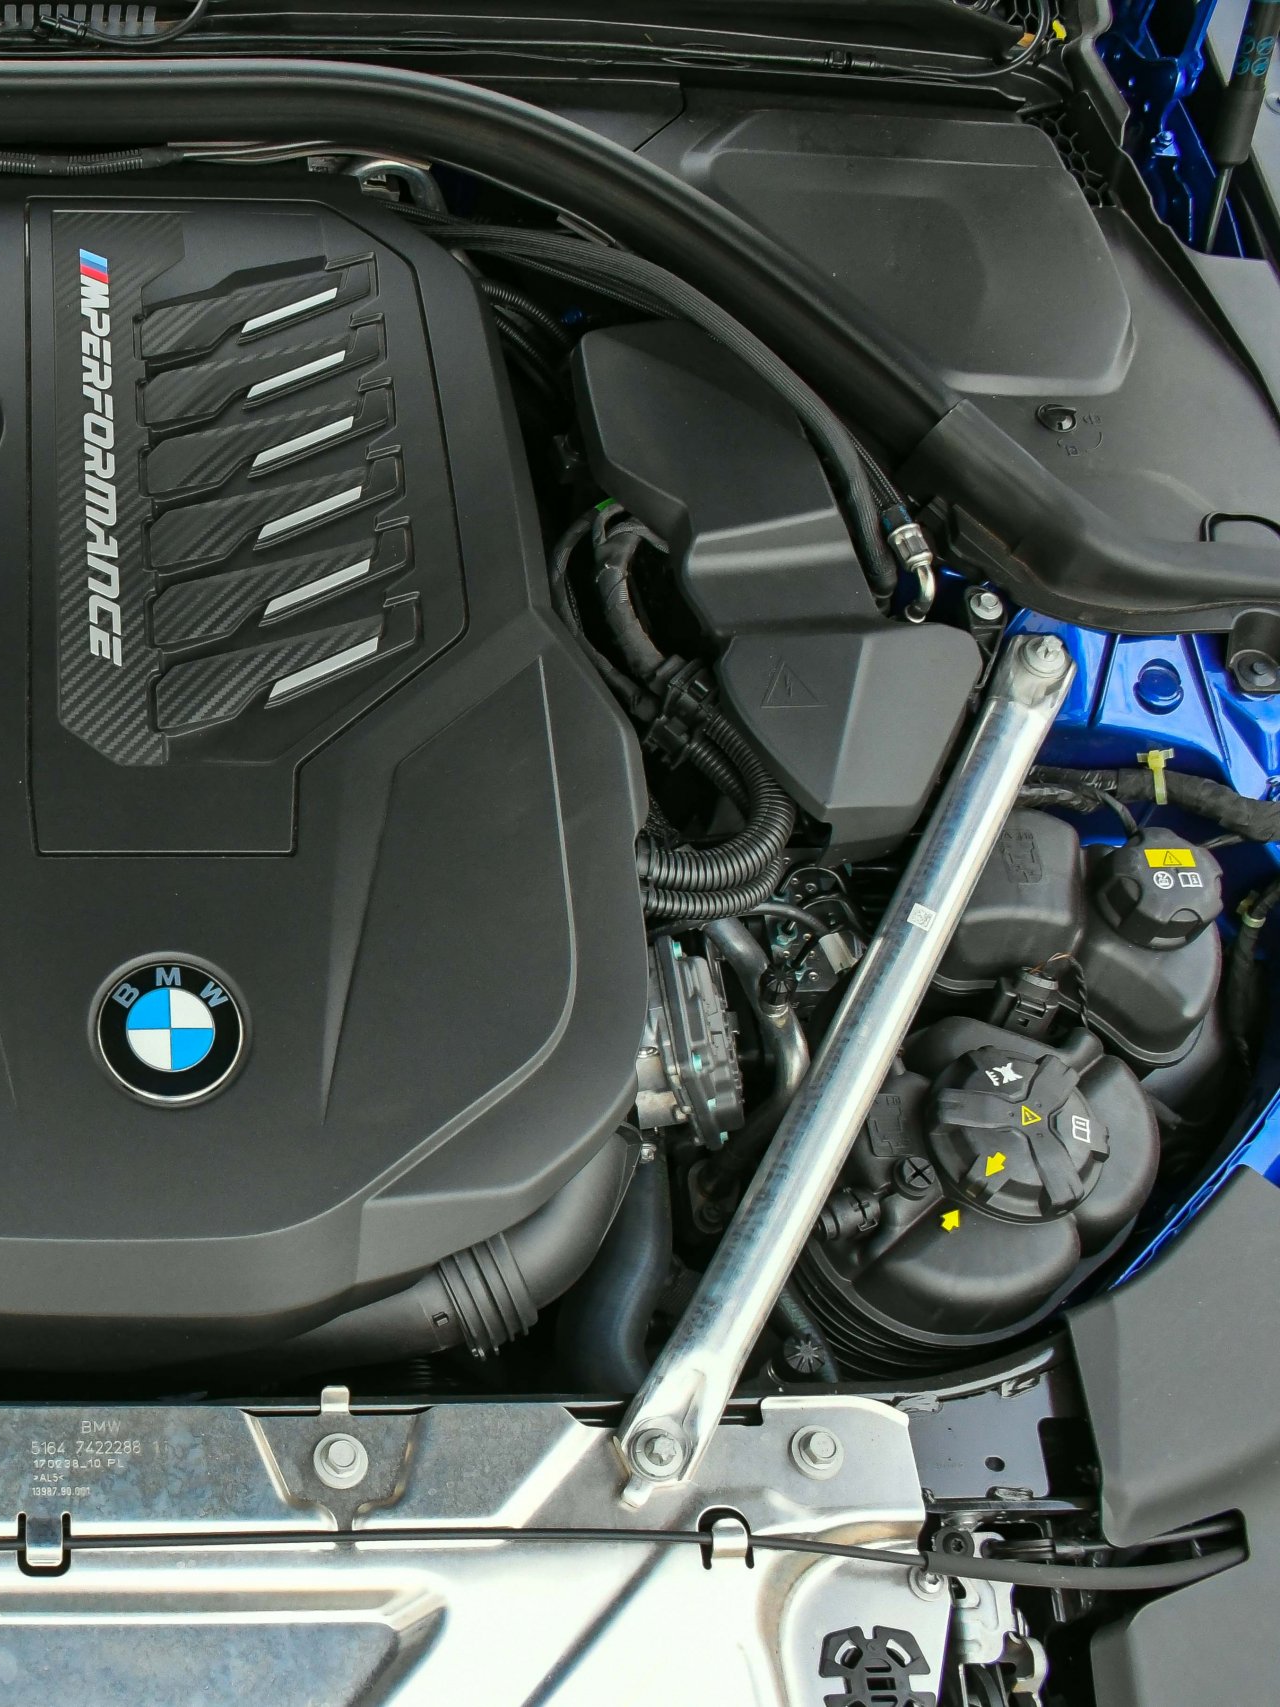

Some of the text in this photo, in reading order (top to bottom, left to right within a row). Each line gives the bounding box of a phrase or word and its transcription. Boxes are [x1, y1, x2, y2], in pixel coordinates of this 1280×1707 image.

[112, 967, 228, 1009] BMW
[81, 1420, 120, 1434] BMW
[31, 1441, 65, 1454] 5164
[76, 1440, 141, 1454] 7422288
